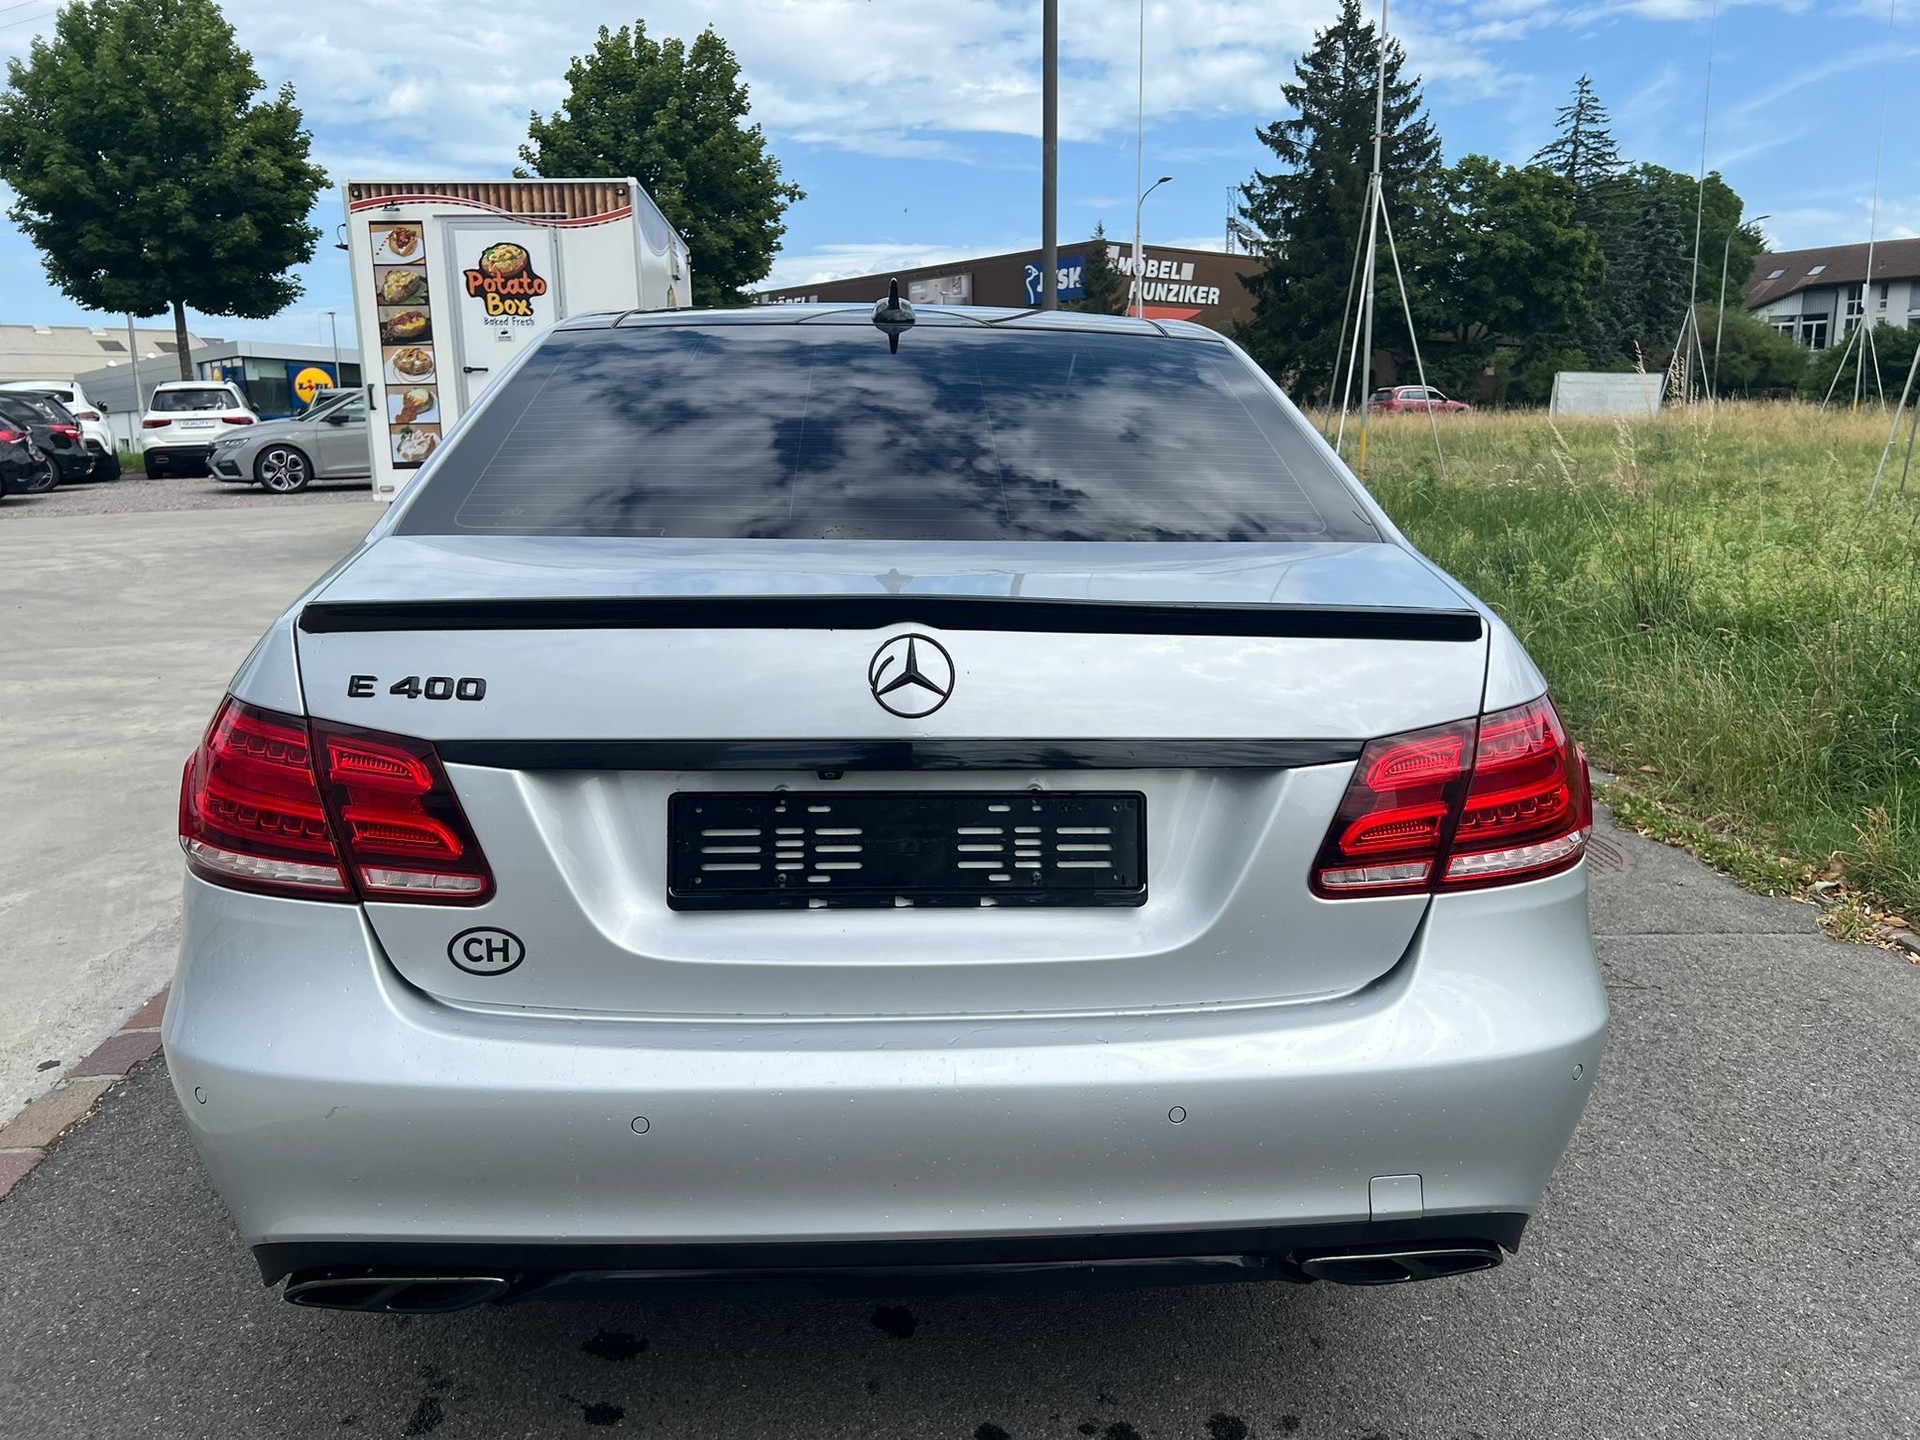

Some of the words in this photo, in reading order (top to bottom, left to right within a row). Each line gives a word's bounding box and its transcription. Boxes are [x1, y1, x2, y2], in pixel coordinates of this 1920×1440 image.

[465, 270, 547, 295] Potato
[1036, 267, 1082, 292] JSK
[487, 293, 532, 315] Box
[484, 317, 509, 326] Baked
[512, 316, 535, 326] Fresh
[347, 674, 378, 698] E
[389, 675, 487, 701] 400
[463, 937, 510, 963] CH
